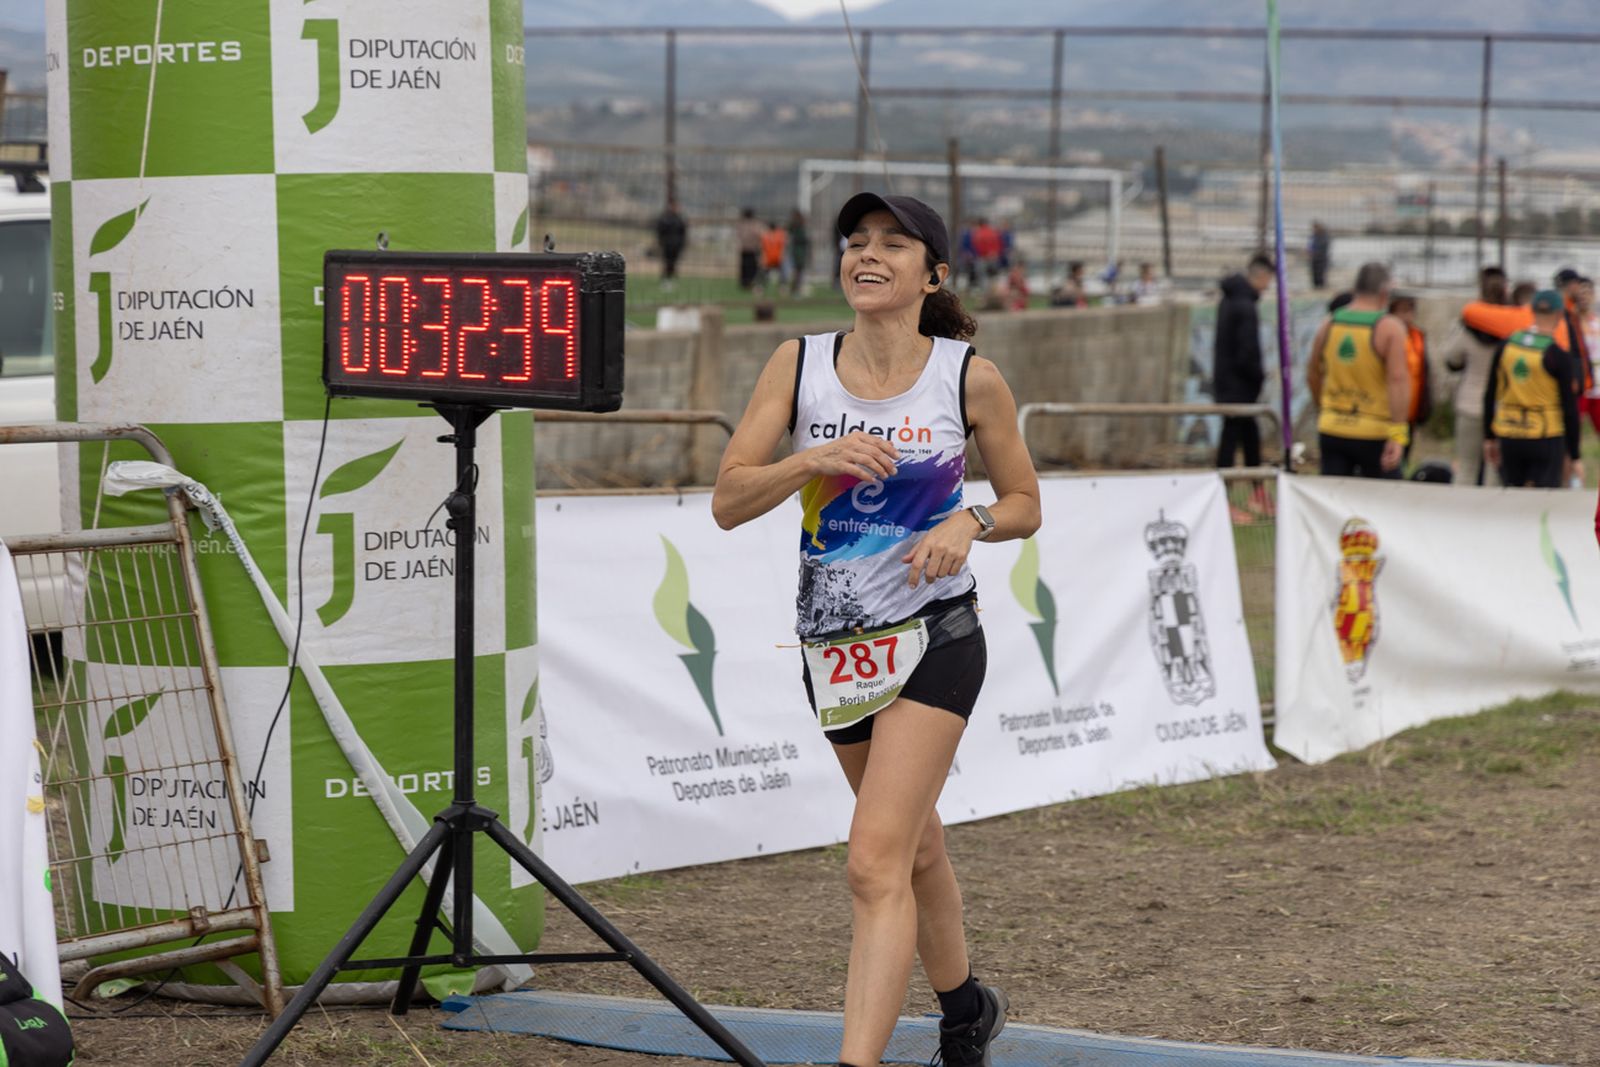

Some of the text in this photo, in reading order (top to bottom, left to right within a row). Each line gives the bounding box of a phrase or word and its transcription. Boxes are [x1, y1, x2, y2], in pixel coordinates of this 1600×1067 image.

[83, 41, 241, 68] DEPORTES
[349, 37, 476, 60] DIPUTACIÓN
[350, 66, 441, 89] DE JAÉN
[117, 285, 254, 310] DIPUTACIÓN
[119, 317, 203, 340] DE JAÉN
[340, 275, 575, 382] 00:32:39
[364, 526, 490, 551] DIPUTACN
[828, 517, 906, 538] entrénate
[365, 555, 455, 581] DE JAÉN
[823, 635, 899, 685] 287
[646, 739, 800, 776] Patronato Municipal de
[131, 777, 266, 799] DIPUTACIN
[325, 766, 491, 798] DEORTS
[672, 766, 792, 805] Deportes de Jaén
[132, 805, 216, 829] DE JAÉN
[552, 796, 600, 831] JAÉN
